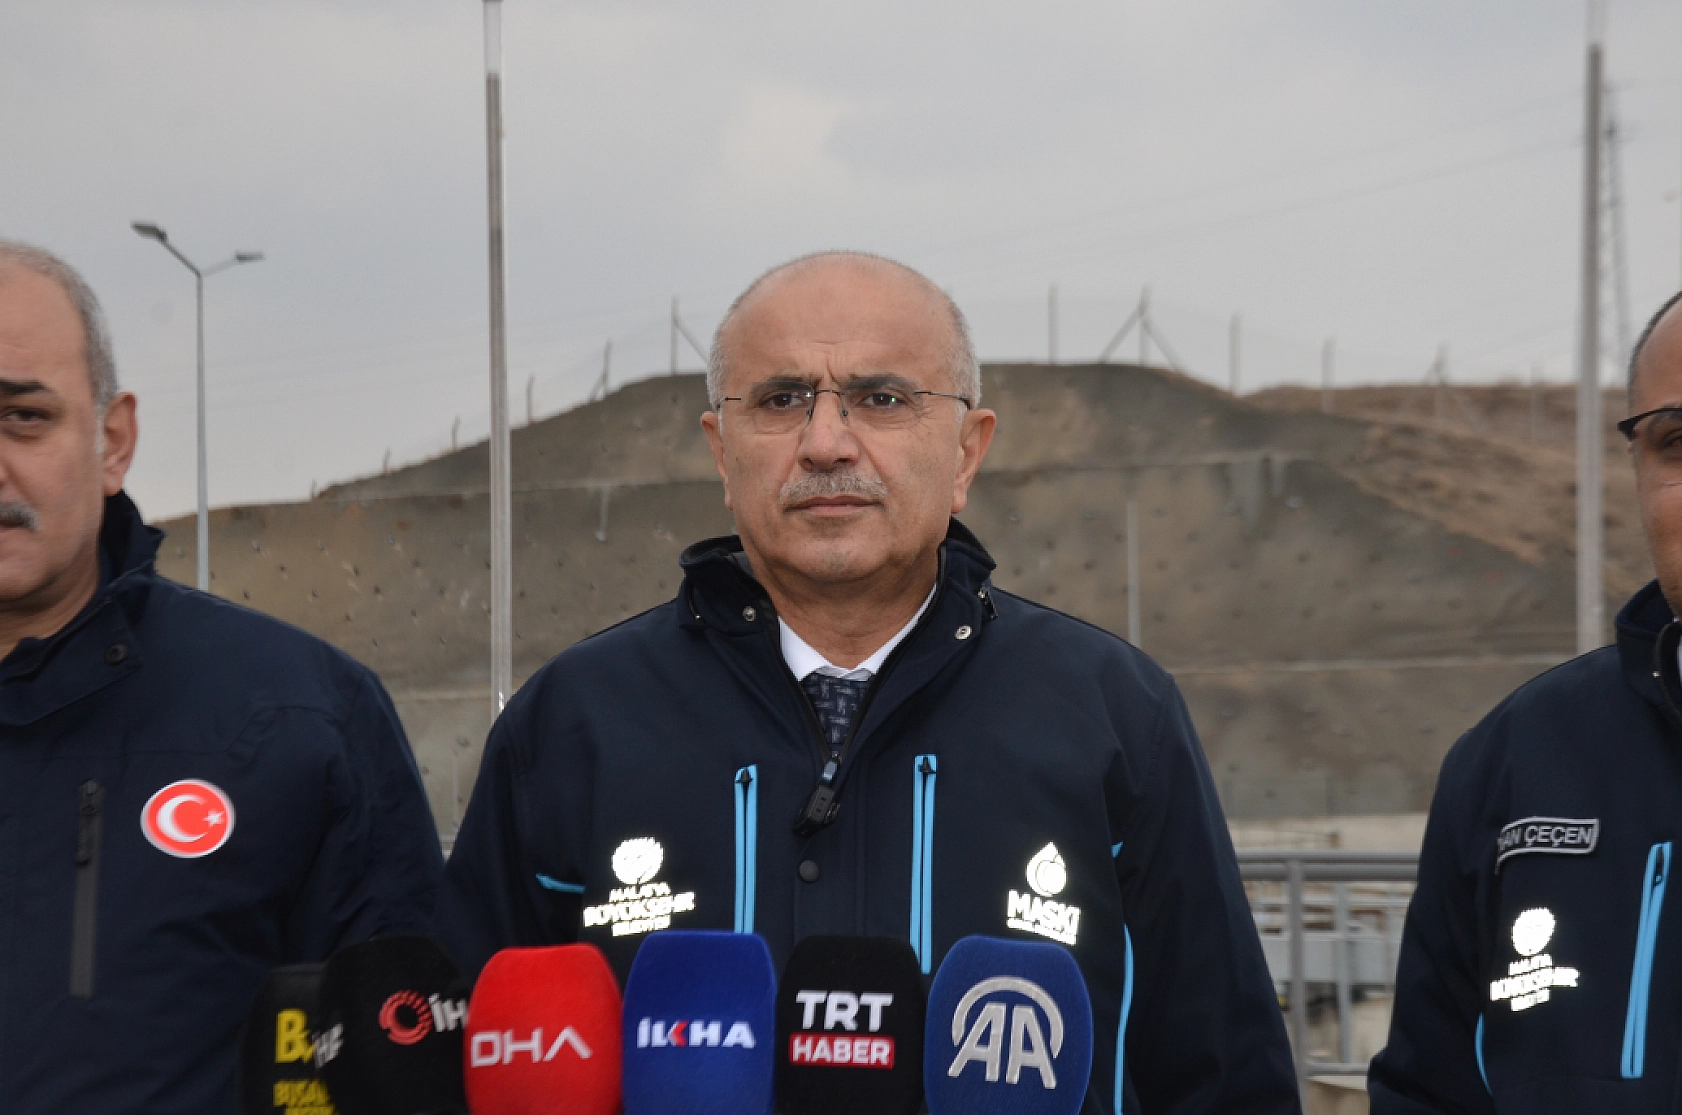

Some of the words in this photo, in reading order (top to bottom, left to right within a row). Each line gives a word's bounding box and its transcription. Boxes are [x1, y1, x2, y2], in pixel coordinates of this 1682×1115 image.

[1524, 825, 1592, 848] ÇEÇEN
[796, 989, 894, 1032] TRT
[471, 1025, 593, 1068] DHA
[791, 1036, 890, 1066] HABER
[947, 1002, 1057, 1090] AA
